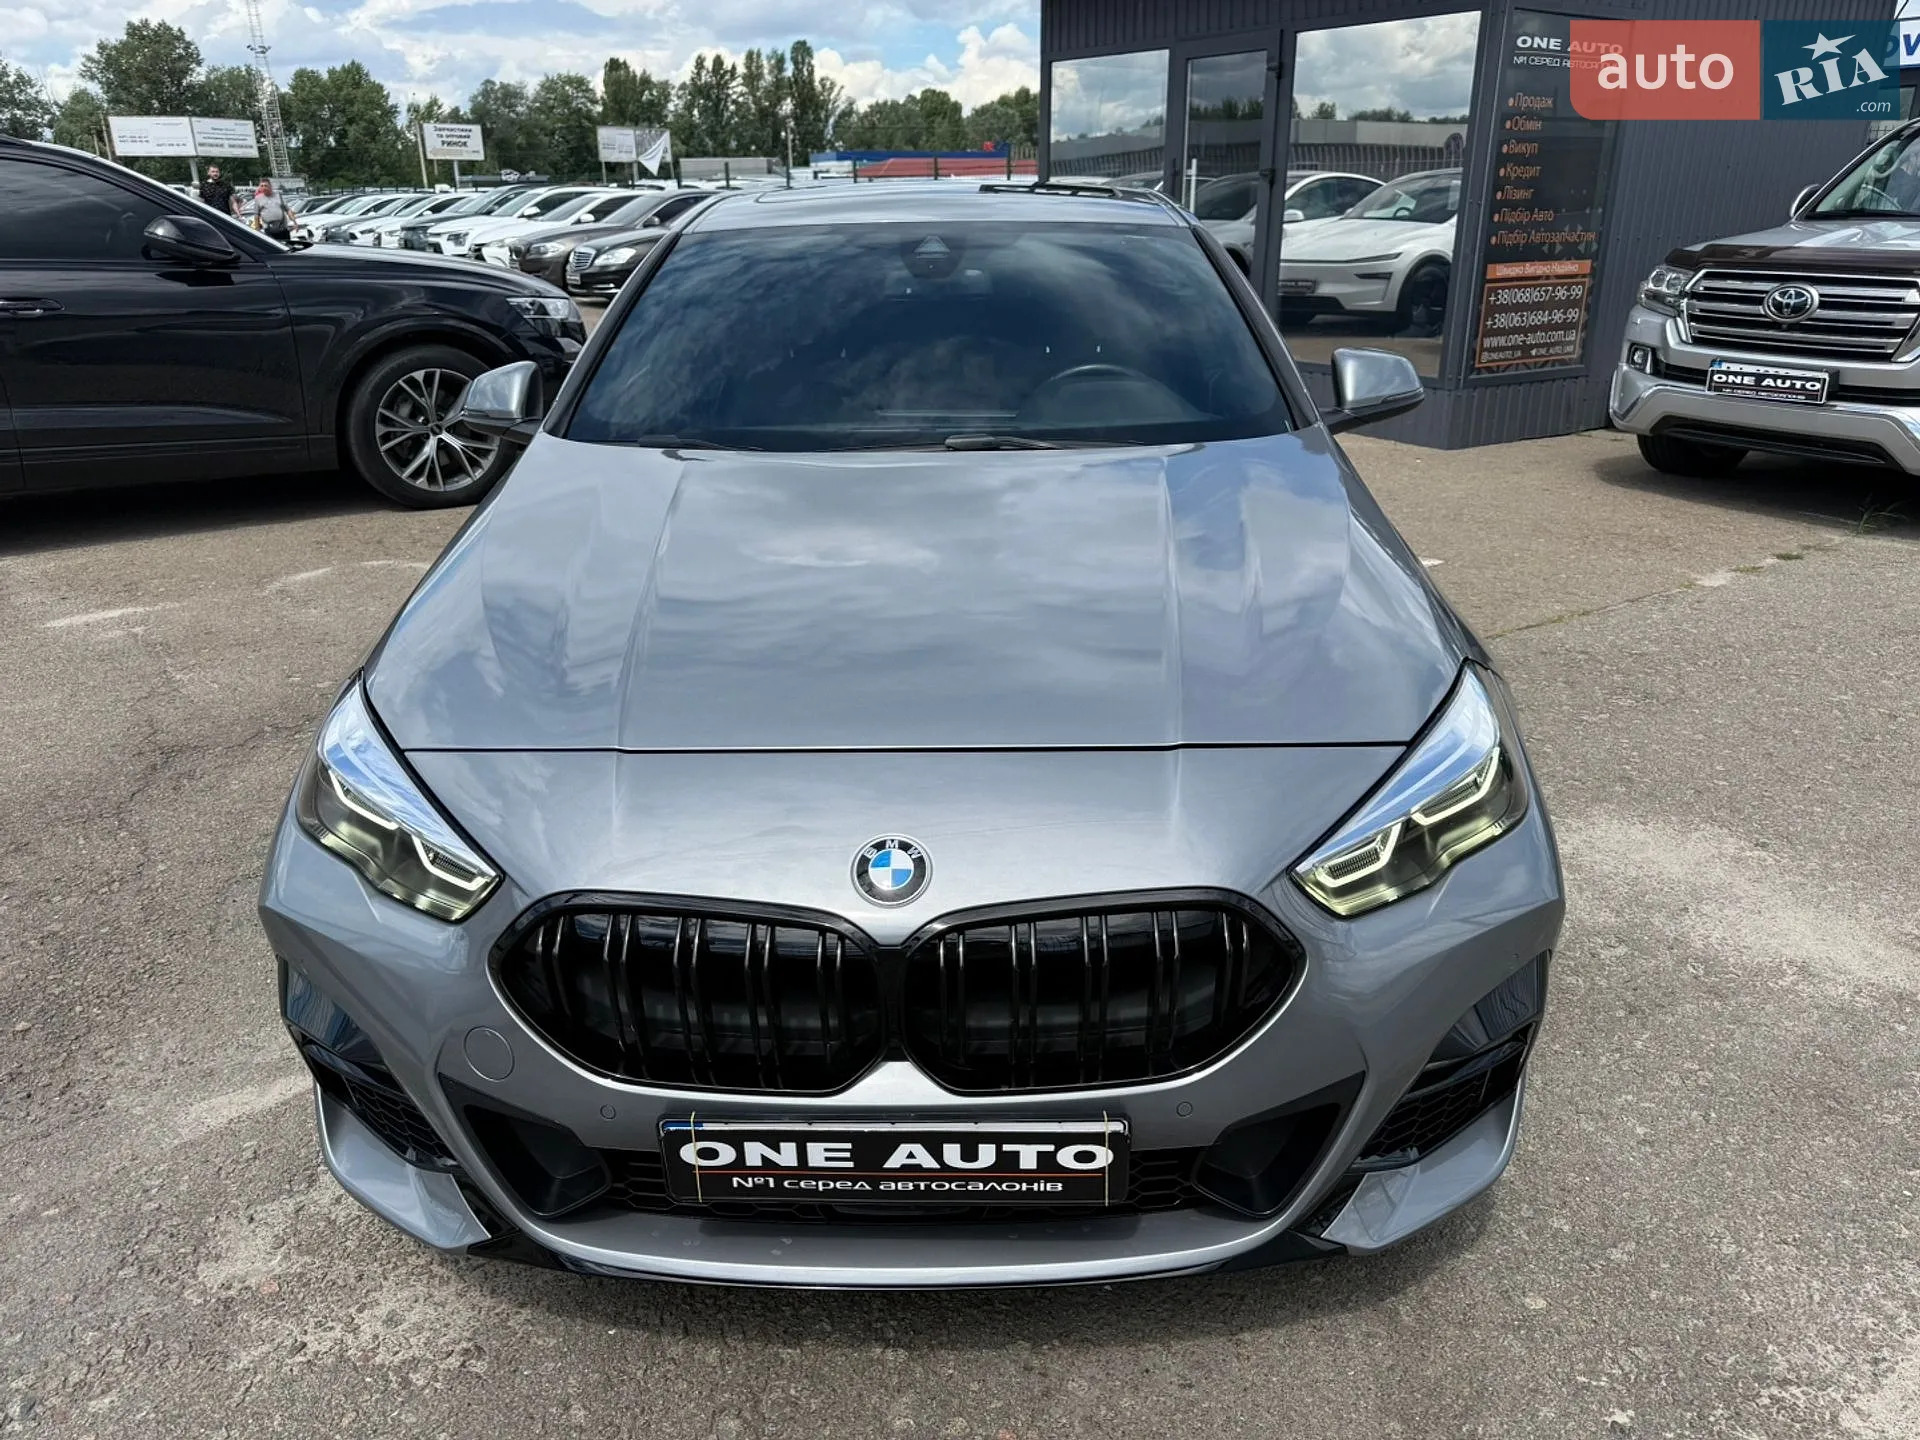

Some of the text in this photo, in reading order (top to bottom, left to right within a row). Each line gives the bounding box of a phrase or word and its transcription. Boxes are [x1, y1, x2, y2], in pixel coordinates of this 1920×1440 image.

[1516, 36, 1623, 54] ONE AUTO
[1528, 56, 1561, 67] СЕРЕД
[1514, 92, 1554, 110] Продаж
[1511, 115, 1542, 131] Обмін
[1508, 139, 1538, 158] Викуп
[1505, 163, 1542, 180] Кредит
[1502, 185, 1534, 200] Лізинг
[1500, 208, 1554, 224] Підбір Авто
[1497, 229, 1596, 247] Підбір Автозапчастин
[1488, 285, 1583, 306] +38(068)657-96-99
[1485, 308, 1579, 329] +38(063)684-96-99
[1483, 329, 1576, 349] www.one-auto.com.ua
[1713, 374, 1821, 390] ONE AUTO
[863, 839, 923, 859] BMW
[679, 1141, 1114, 1170] ONE AUTO
[731, 1176, 1063, 1192] №1 серед автосалонів
